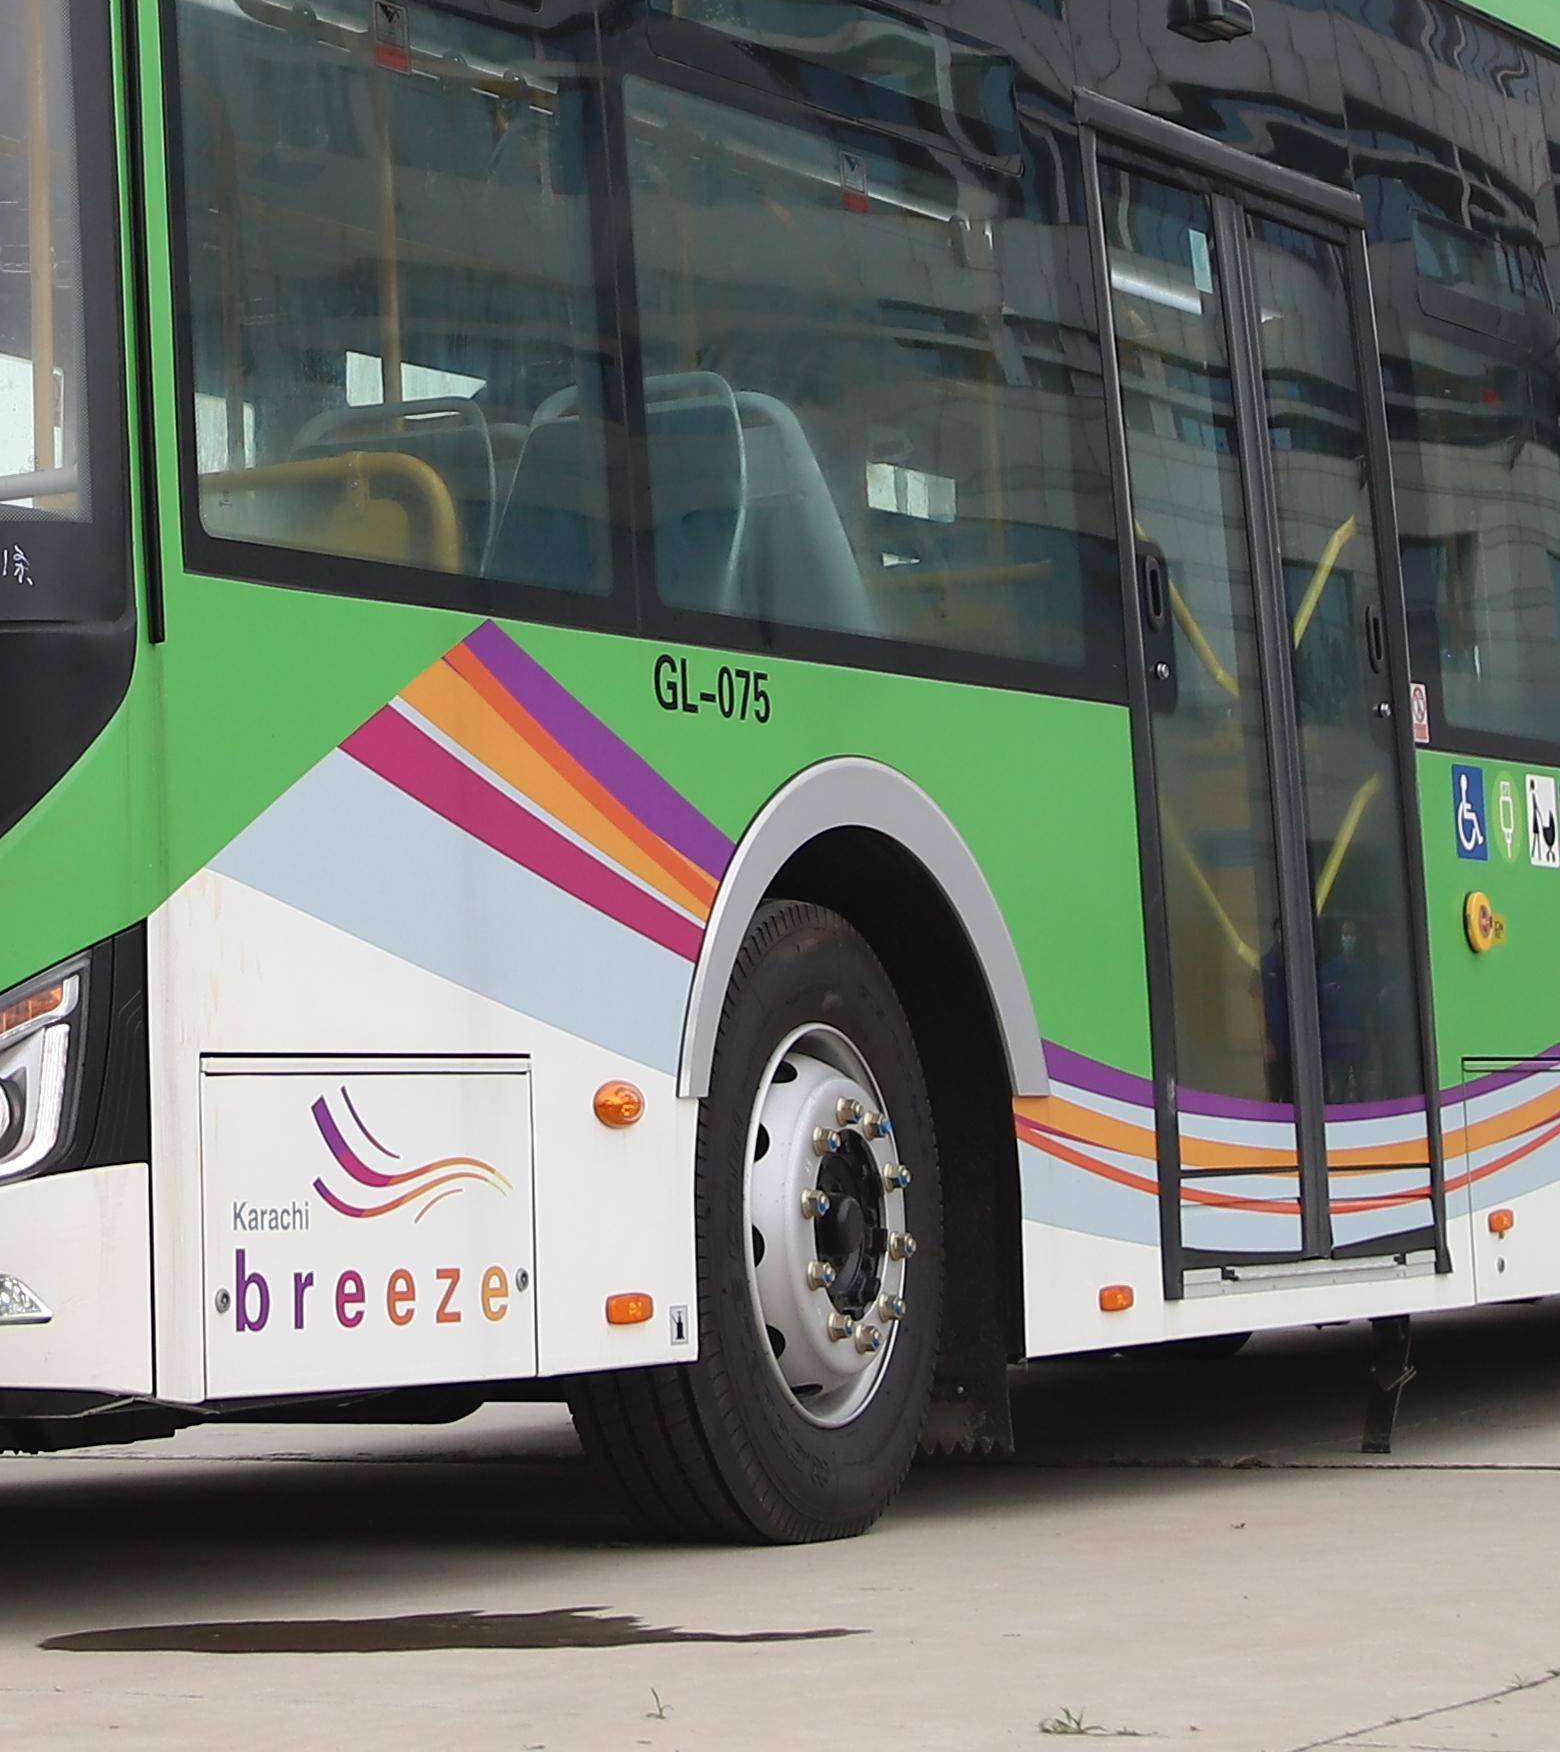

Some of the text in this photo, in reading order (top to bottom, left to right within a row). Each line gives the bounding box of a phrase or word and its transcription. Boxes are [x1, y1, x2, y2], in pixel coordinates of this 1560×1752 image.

[653, 653, 771, 724] GL-075
[232, 1200, 311, 1232] Karachi
[234, 1248, 510, 1333] breeze
